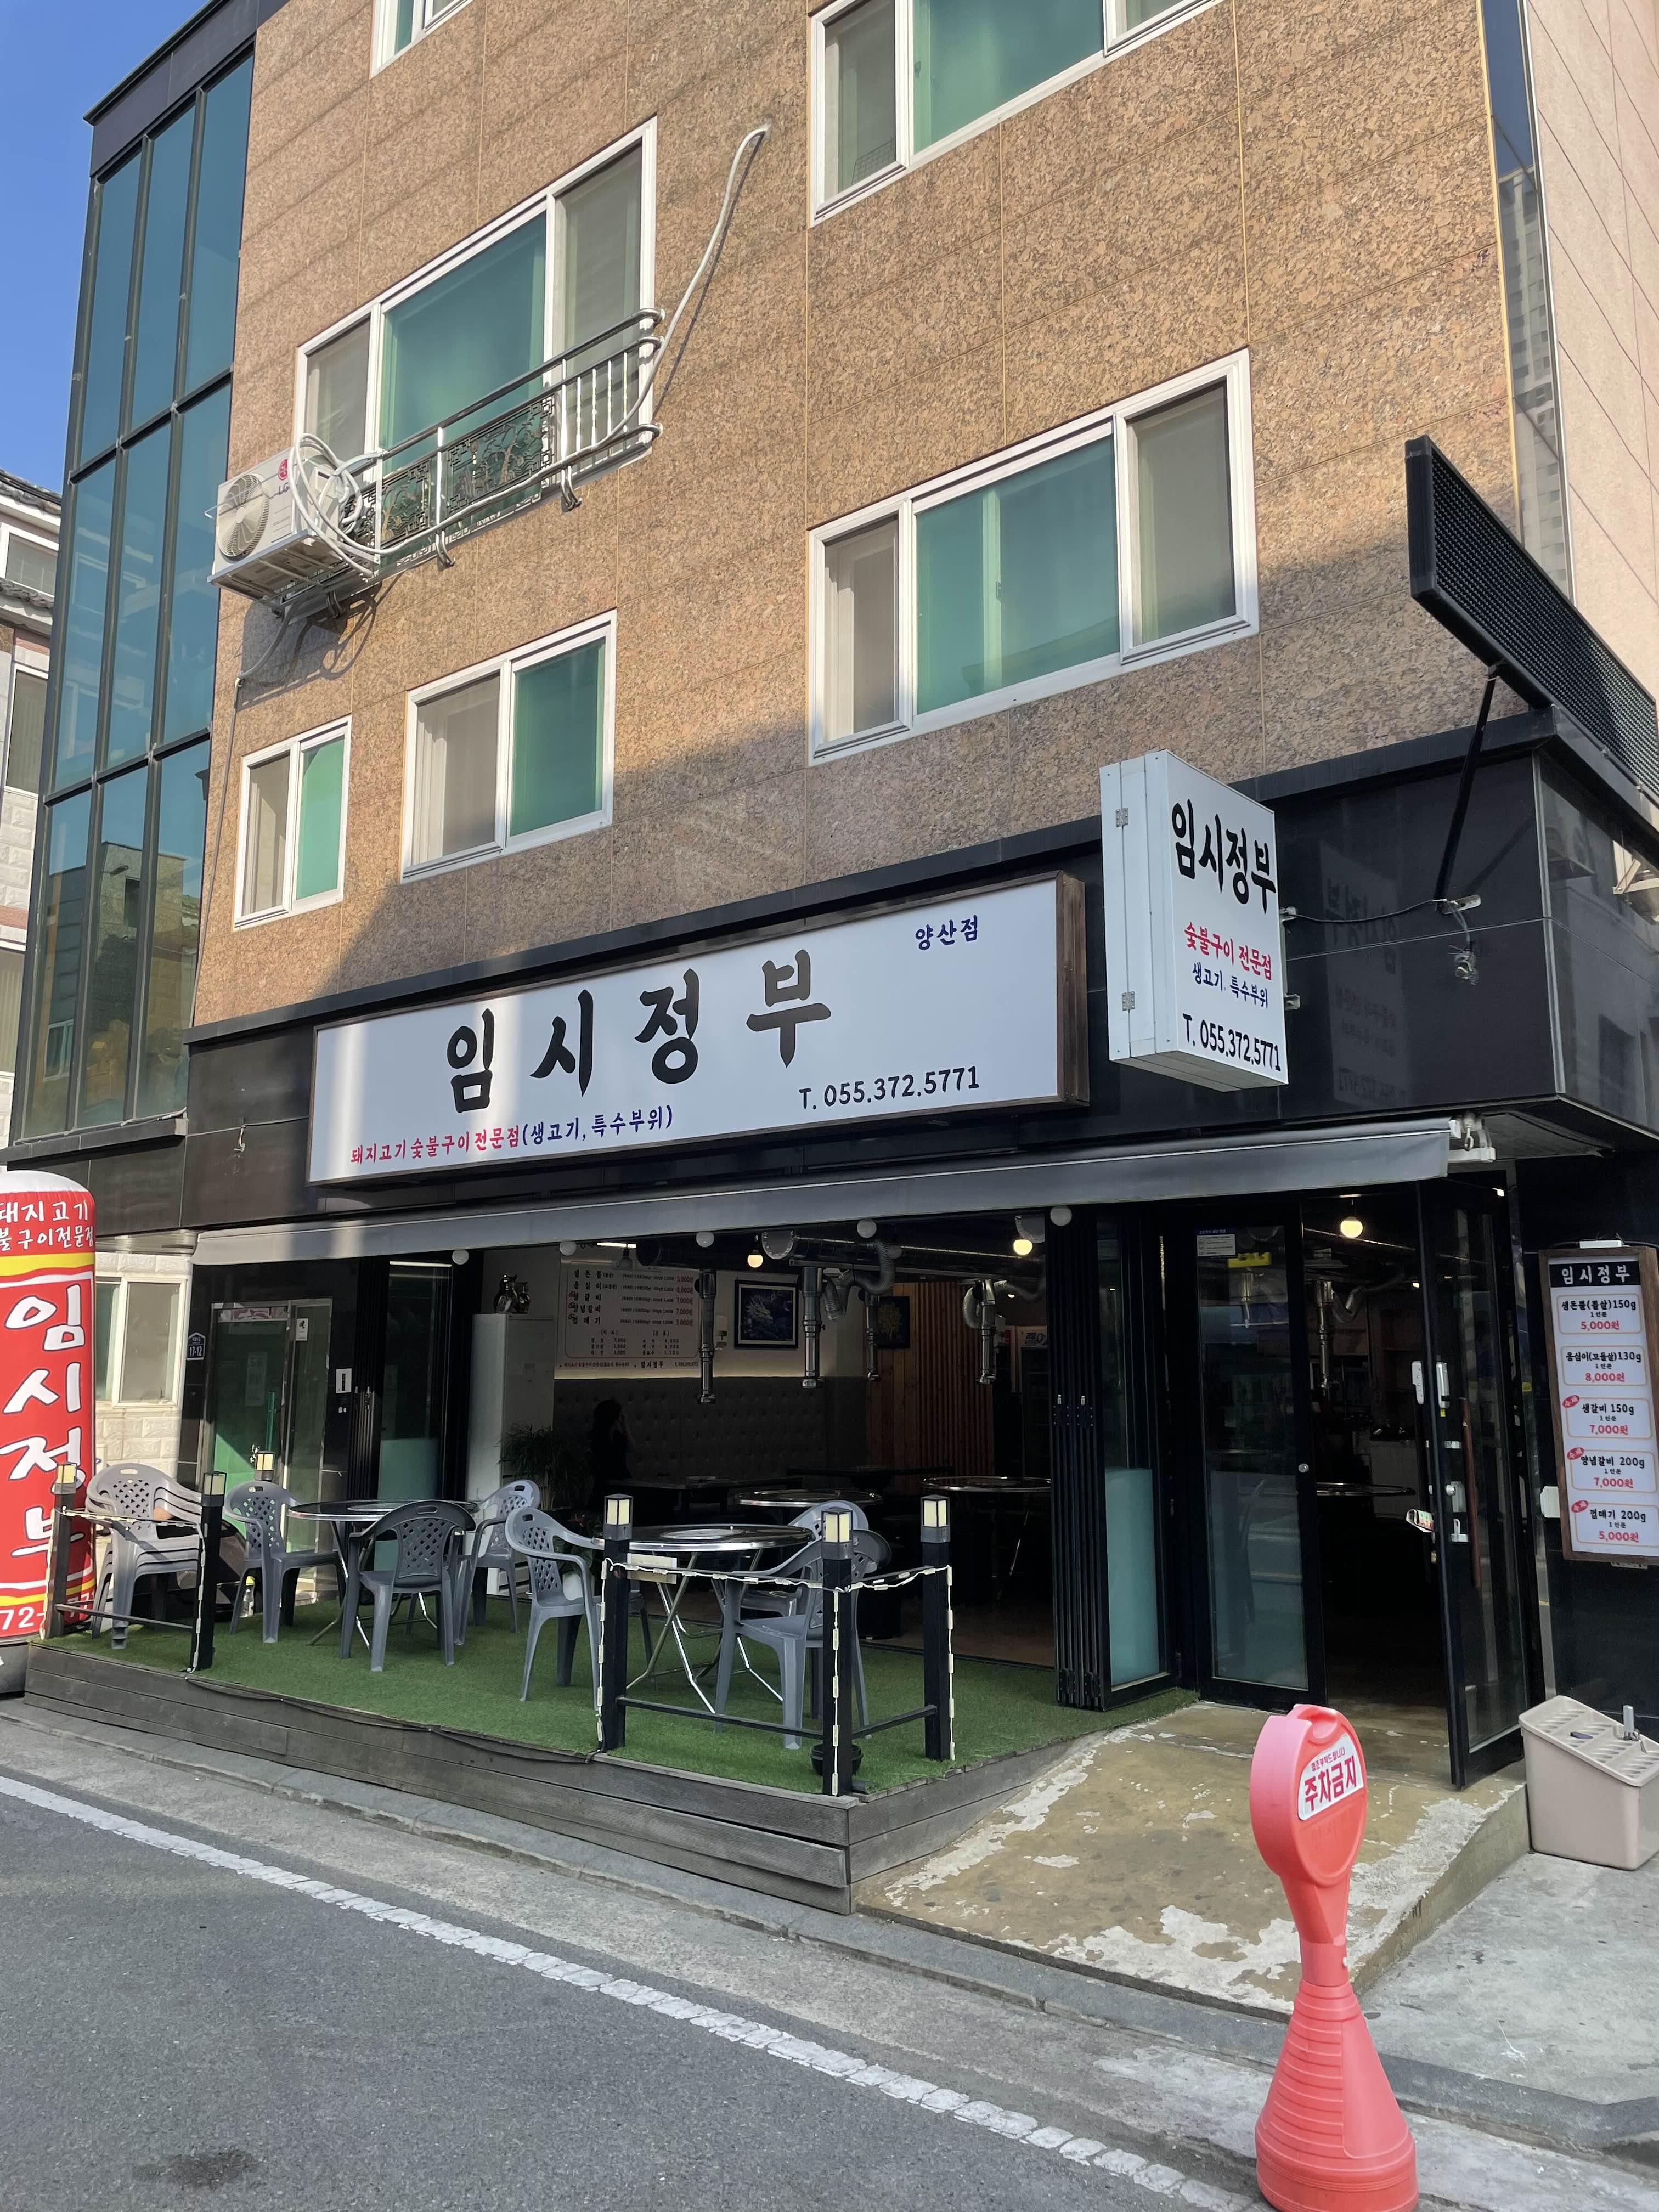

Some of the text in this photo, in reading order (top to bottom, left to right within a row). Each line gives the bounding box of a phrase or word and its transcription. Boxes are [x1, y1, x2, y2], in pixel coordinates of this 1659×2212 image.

[1172, 799, 1276, 915] 임시정부
[915, 915, 979, 950] 양산점
[1184, 921, 1272, 980] 숯불구이 전문점
[1230, 975, 1268, 1009] 특수부위
[447, 949, 832, 1114] 임시정부
[824, 1066, 980, 1107] 055.372.5771
[351, 1139, 407, 1165] 돼지고기
[410, 1131, 470, 1160] 숯불구이
[591, 1104, 673, 1137] 특수부위)
[1561, 1264, 1632, 1285] 임시정부
[1581, 1320, 1620, 1331] 5,000원
[189, 1346, 202, 1357] 17-12
[1585, 1372, 1625, 1383] 8,000원
[1582, 1403, 1634, 1415] 생갈비 150g
[1589, 1425, 1628, 1435] 7,000원
[1581, 1455, 1644, 1469] 양념갈비 200g
[1594, 1477, 1633, 1488] 7,000원
[1621, 1510, 1646, 1523] 200g
[1599, 1530, 1639, 1543] 5,000원
[1305, 1755, 1356, 1812] 주차금지
